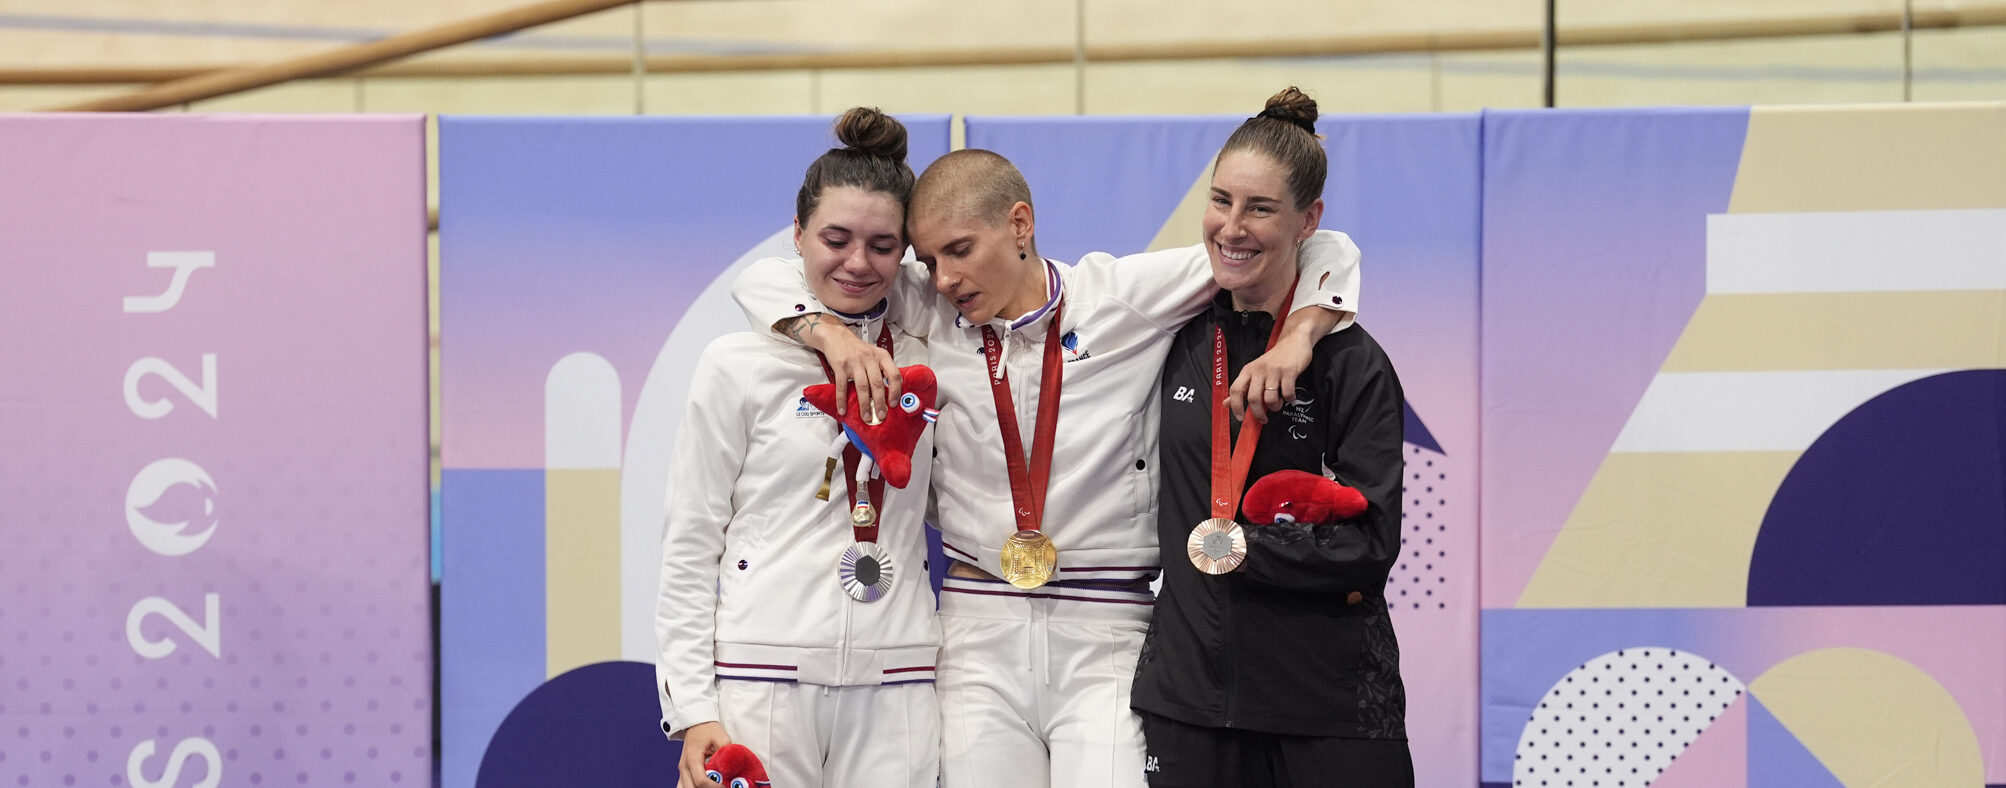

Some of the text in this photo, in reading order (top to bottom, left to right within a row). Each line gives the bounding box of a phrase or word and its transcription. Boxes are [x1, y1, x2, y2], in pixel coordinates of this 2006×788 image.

[1296, 406, 1304, 414] NZ
[1282, 410, 1314, 423] PARALYMPIC
[1292, 416, 1307, 424] TEAM
[122, 250, 221, 660] 2024
